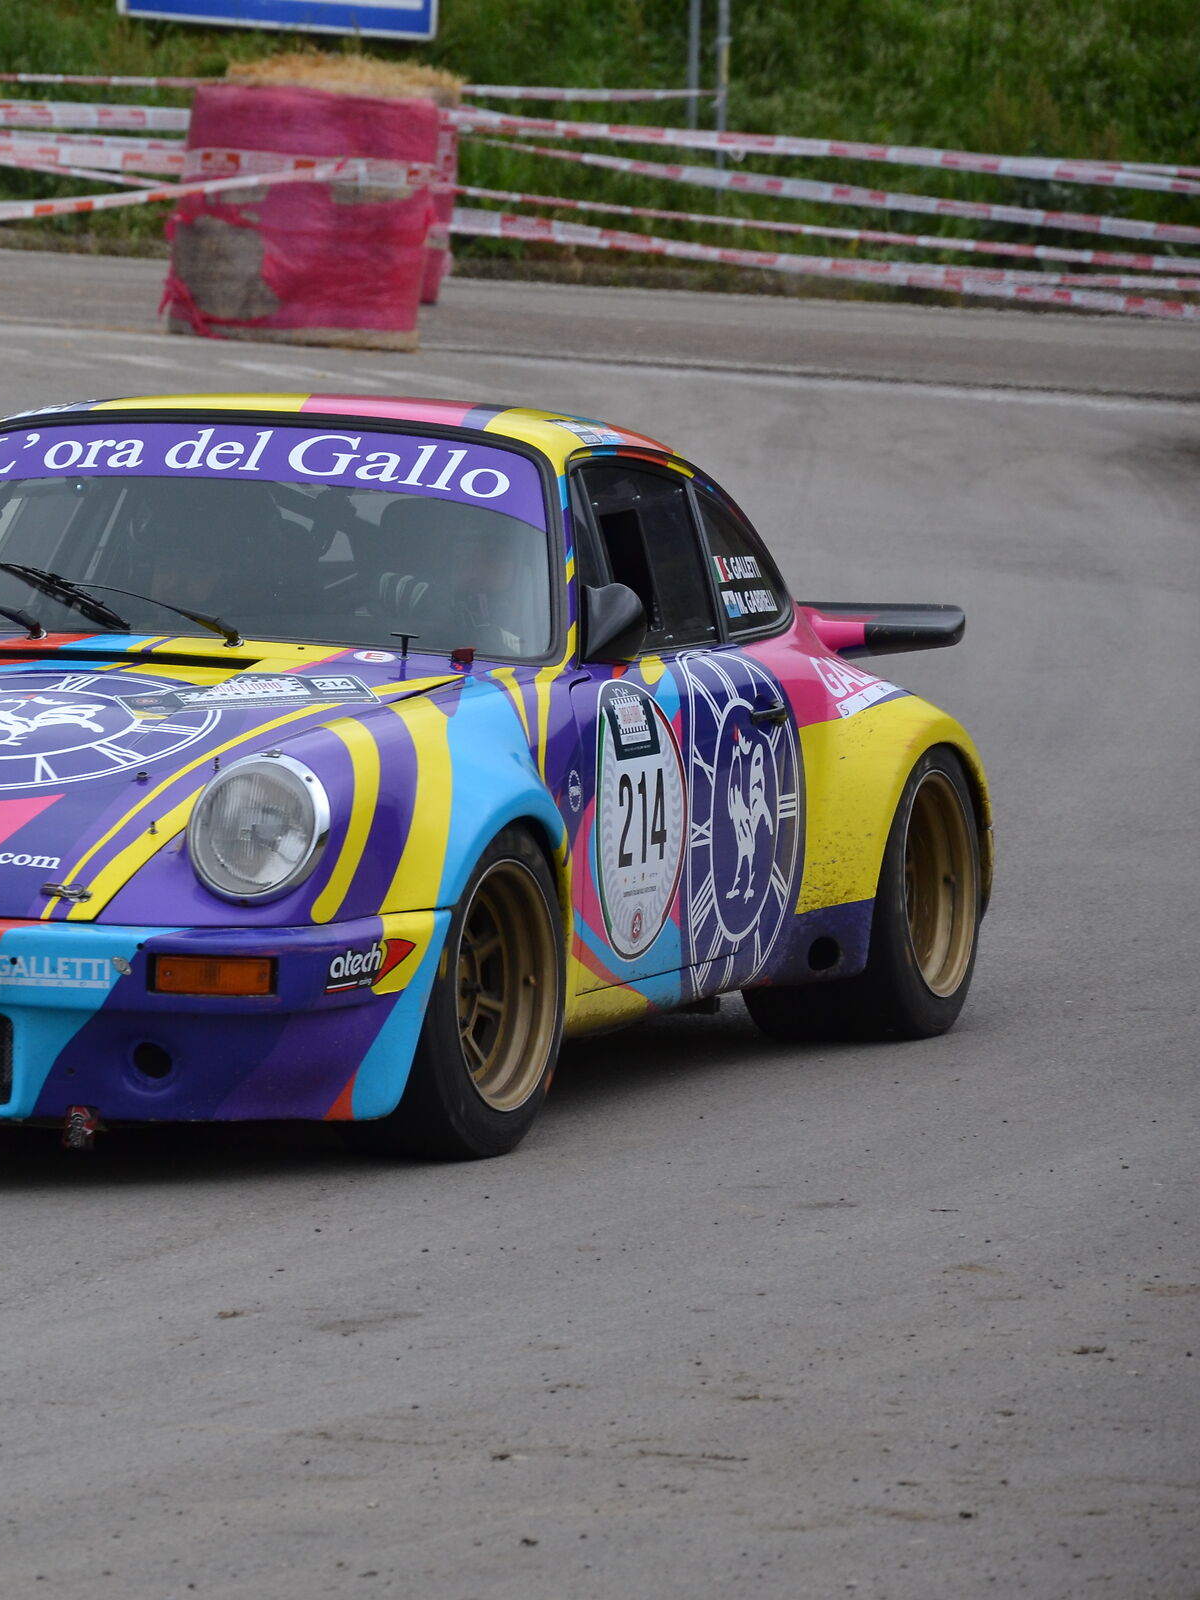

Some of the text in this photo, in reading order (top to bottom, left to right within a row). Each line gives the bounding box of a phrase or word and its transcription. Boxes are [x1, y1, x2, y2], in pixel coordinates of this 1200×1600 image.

[164, 428, 274, 471] del
[287, 434, 511, 498] Gallo
[730, 555, 762, 579] GALLETTI
[315, 680, 352, 690] 214
[618, 768, 667, 868] 214
[330, 942, 382, 979] atech
